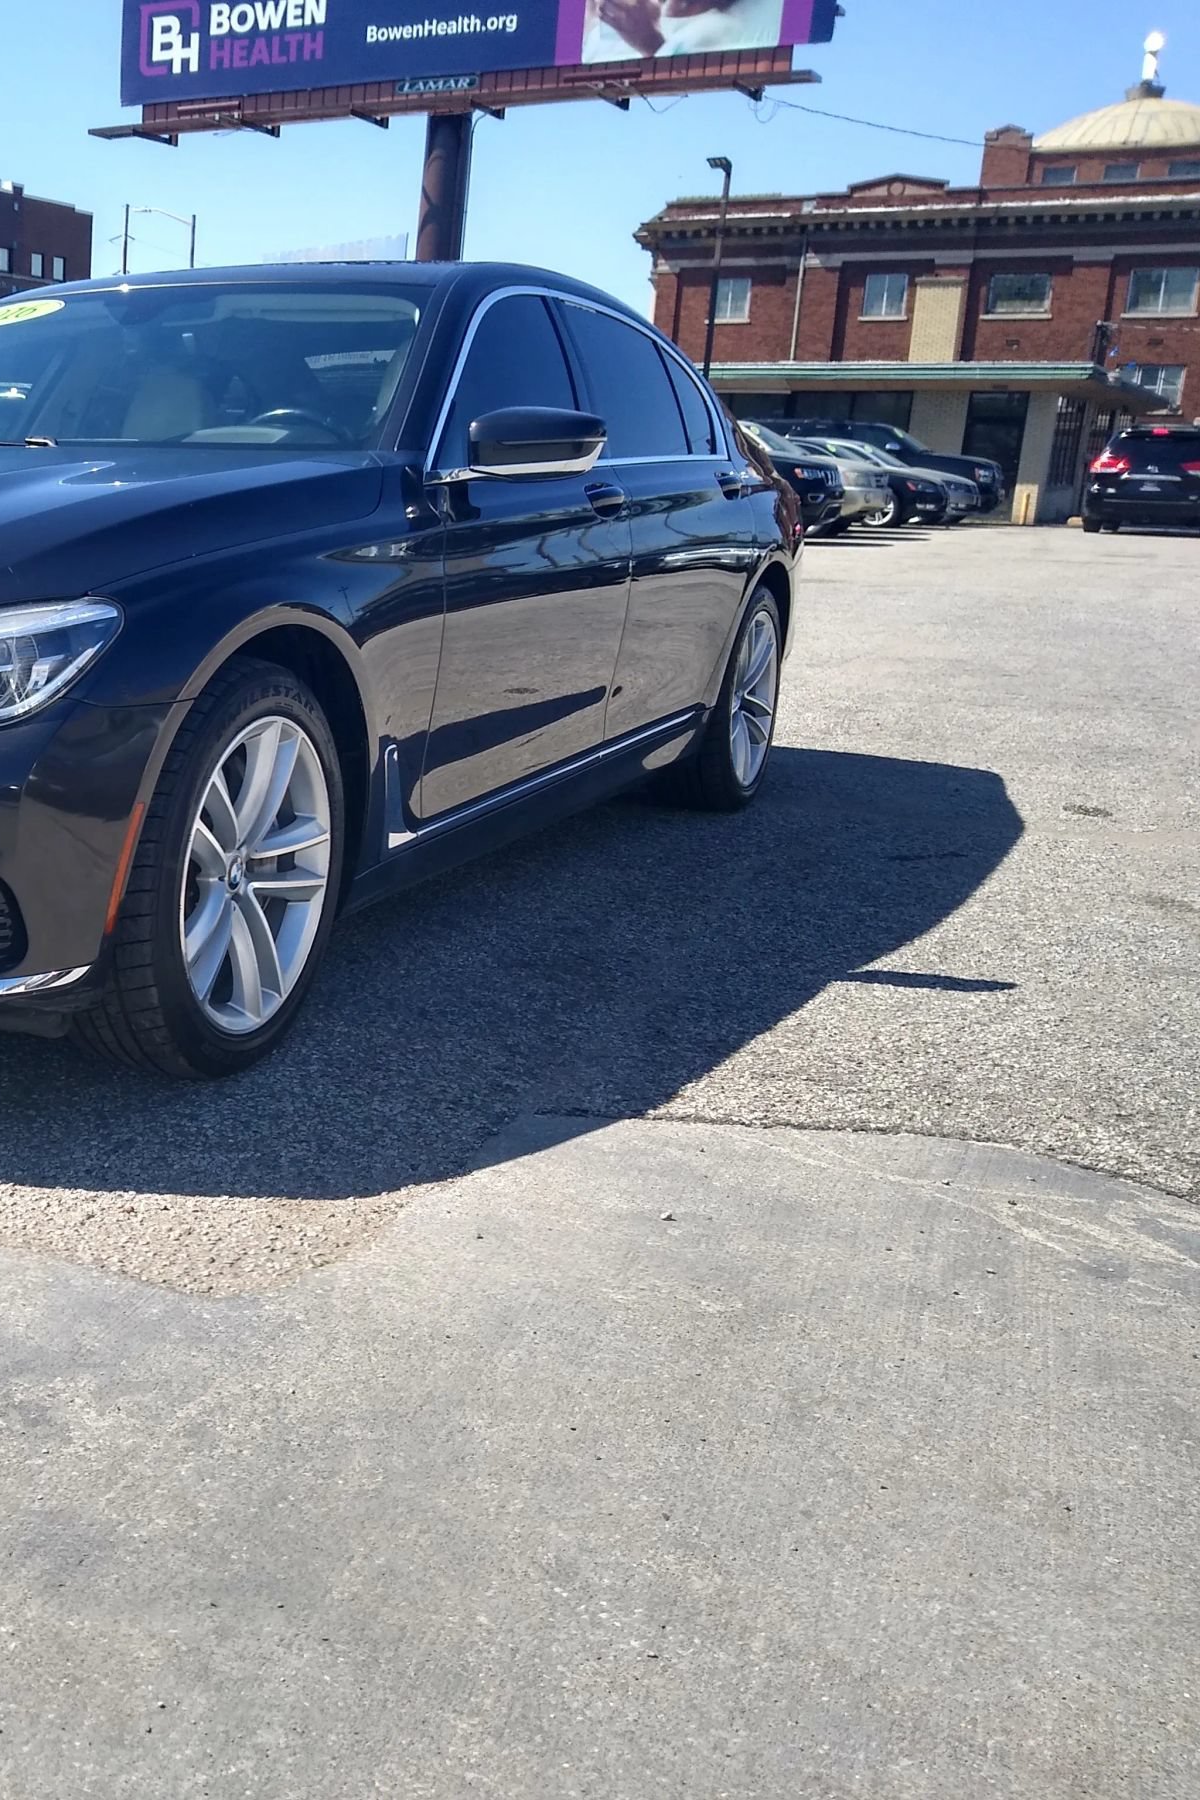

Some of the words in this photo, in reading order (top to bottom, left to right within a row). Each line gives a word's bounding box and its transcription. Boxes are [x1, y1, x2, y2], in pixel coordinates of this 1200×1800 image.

[209, 0, 327, 36] BOWEN
[366, 13, 518, 43] BowenHealth.org
[209, 31, 324, 70] HEALTH
[403, 77, 470, 93] LAMAR
